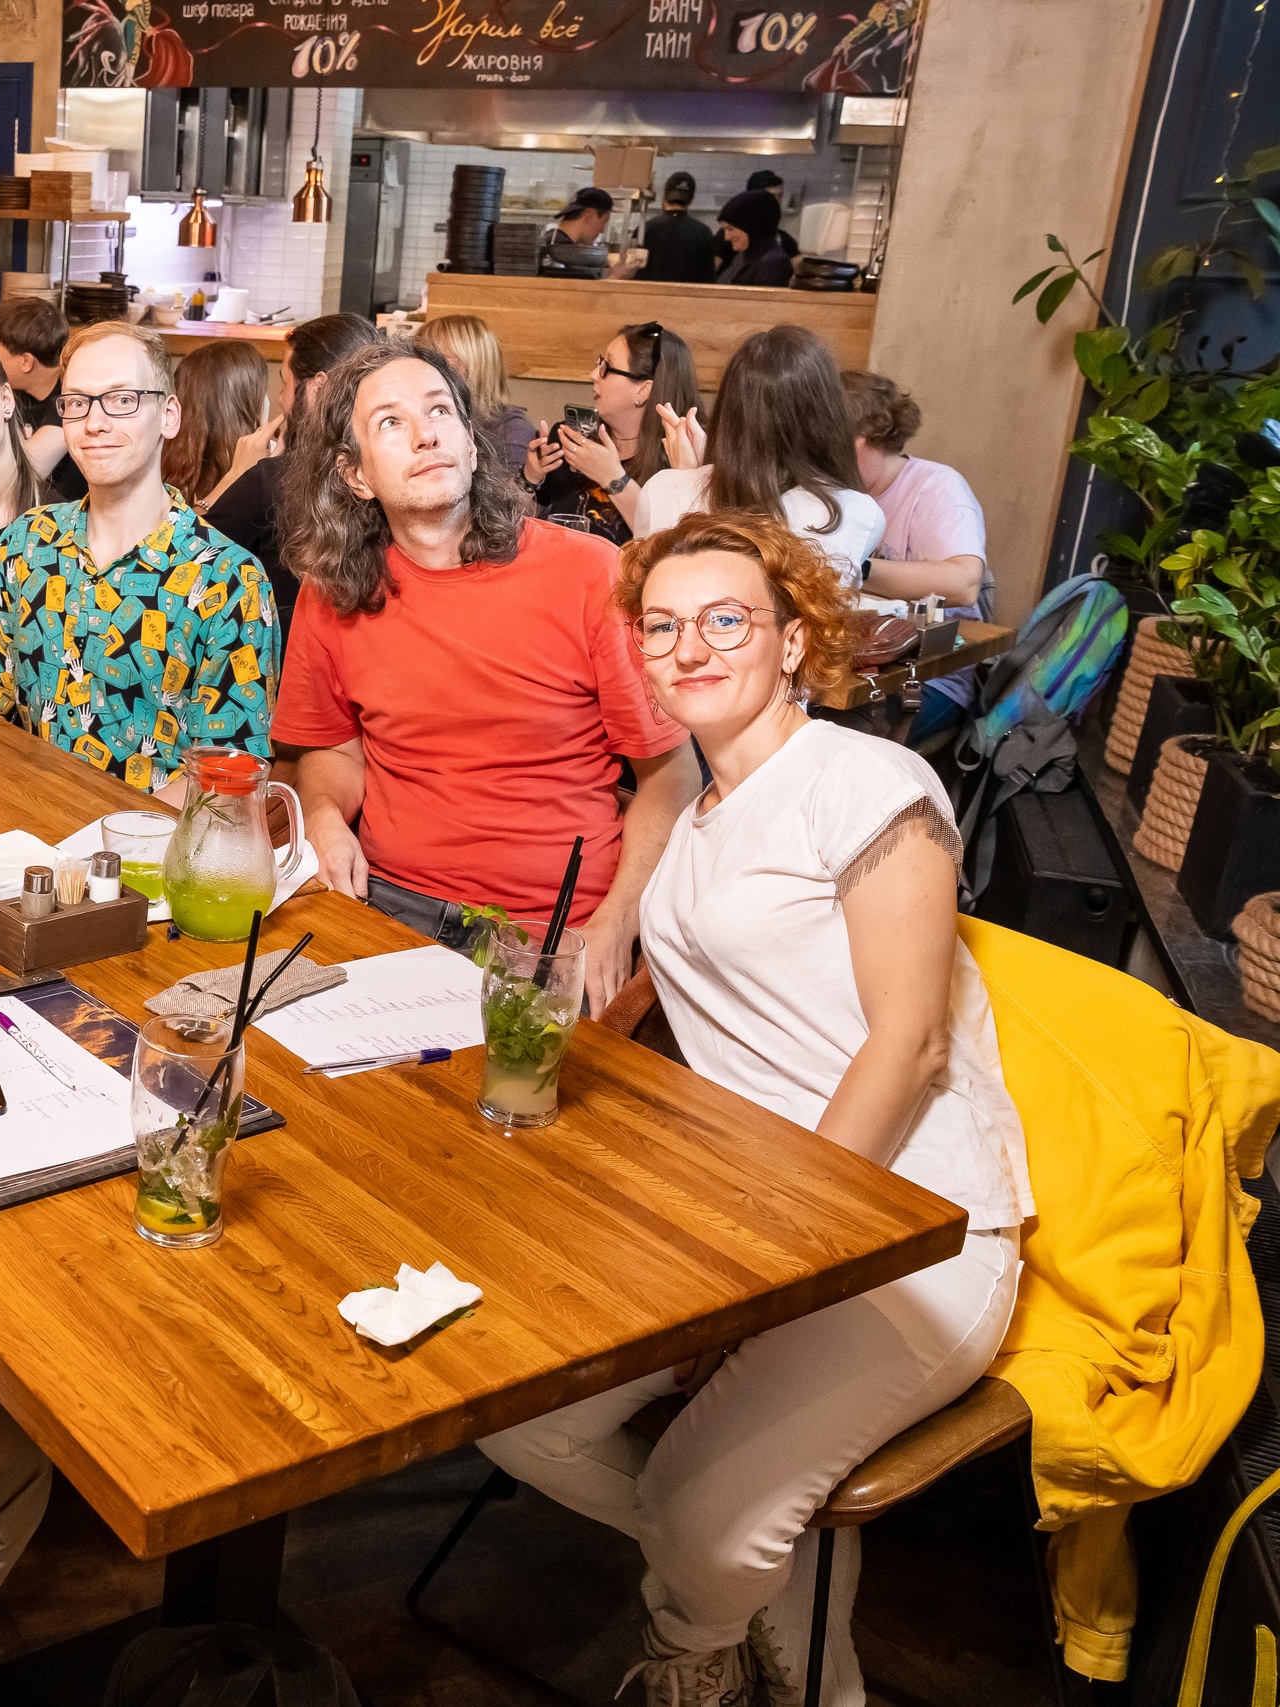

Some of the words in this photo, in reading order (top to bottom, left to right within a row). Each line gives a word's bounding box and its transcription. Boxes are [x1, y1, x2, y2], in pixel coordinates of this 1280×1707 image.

[182, 3, 209, 24] шеф
[210, 3, 255, 23] повара
[283, 13, 348, 31] РОЖДЕНИЯ
[647, 0, 704, 24] БРАНЧ
[645, 29, 692, 59] ТАЙМ
[736, 11, 818, 56] 10%
[291, 30, 361, 78] 10%
[462, 54, 544, 71] ЖАРОВНЯ
